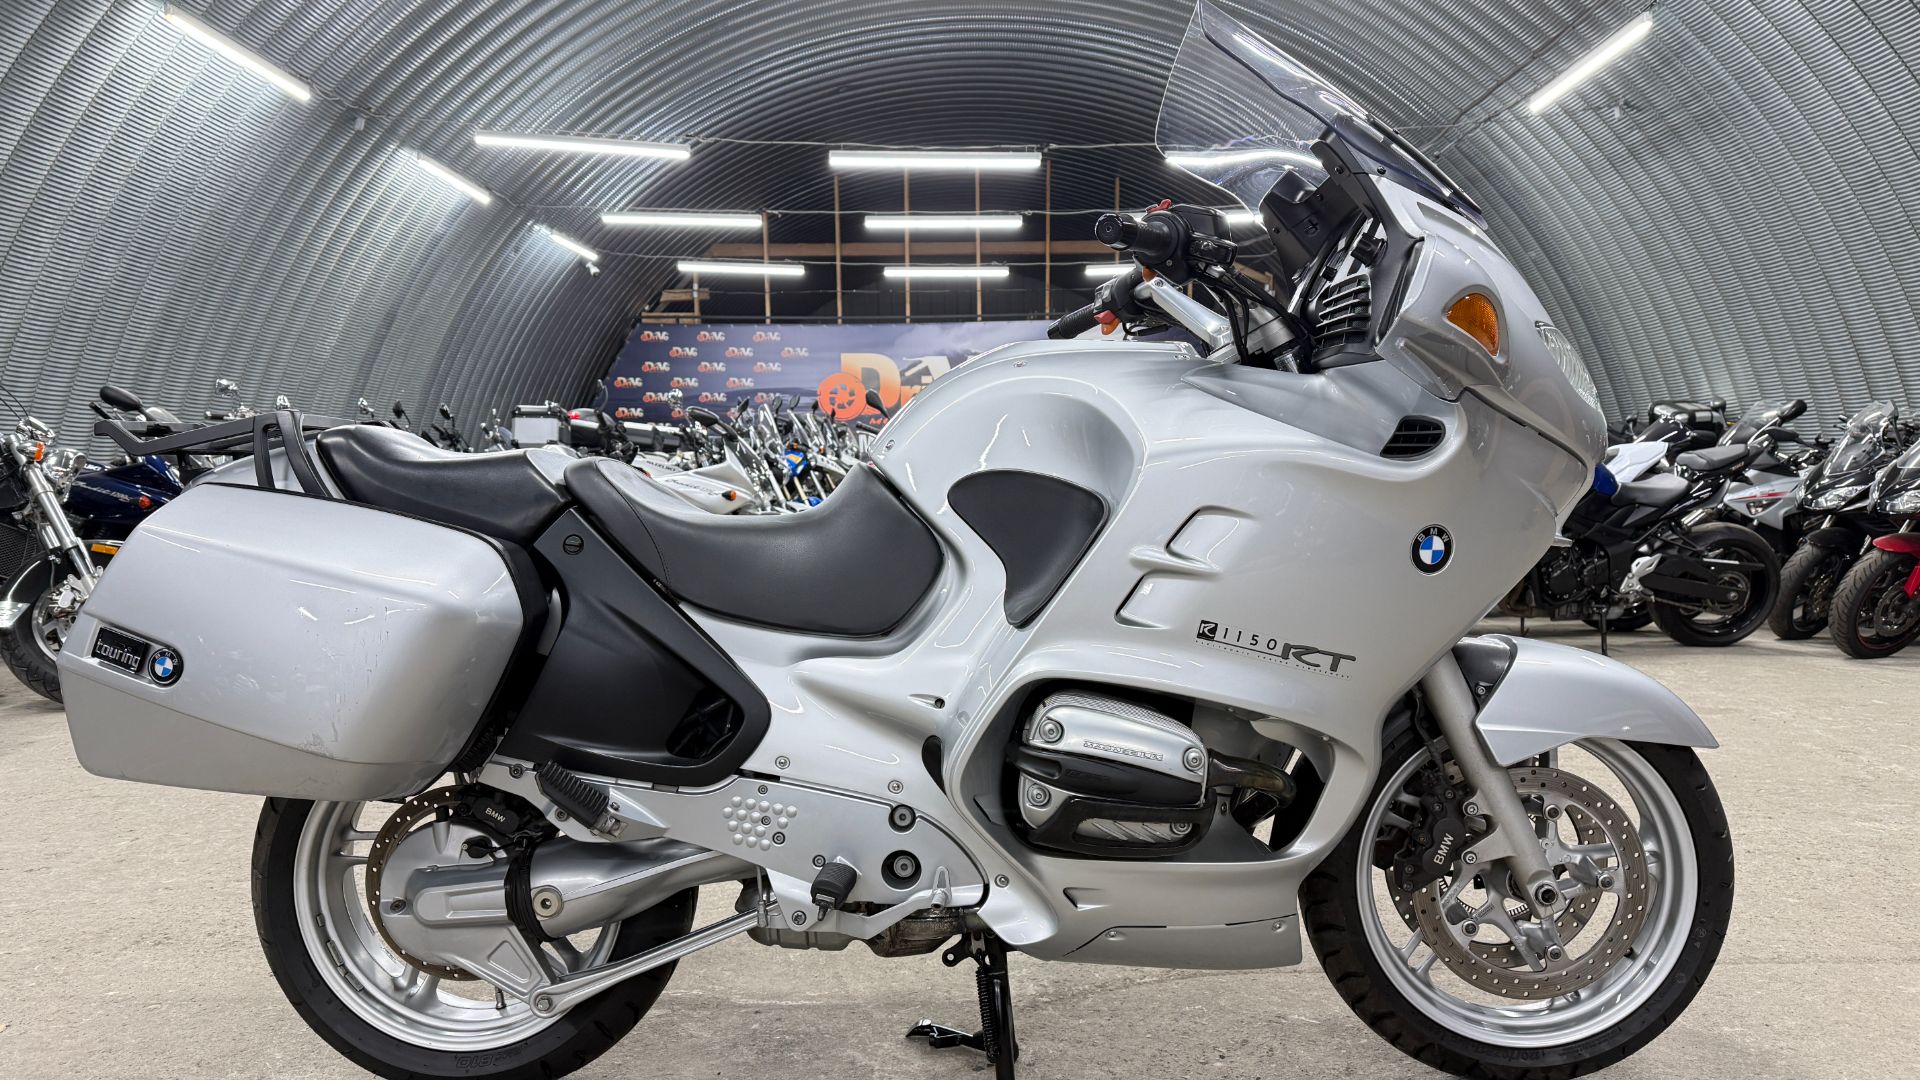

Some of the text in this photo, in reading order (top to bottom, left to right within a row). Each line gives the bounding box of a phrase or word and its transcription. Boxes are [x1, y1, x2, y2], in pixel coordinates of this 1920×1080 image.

[95, 638, 141, 671] touring
[485, 807, 506, 822] BMW
[1433, 833, 1455, 865] BMW
